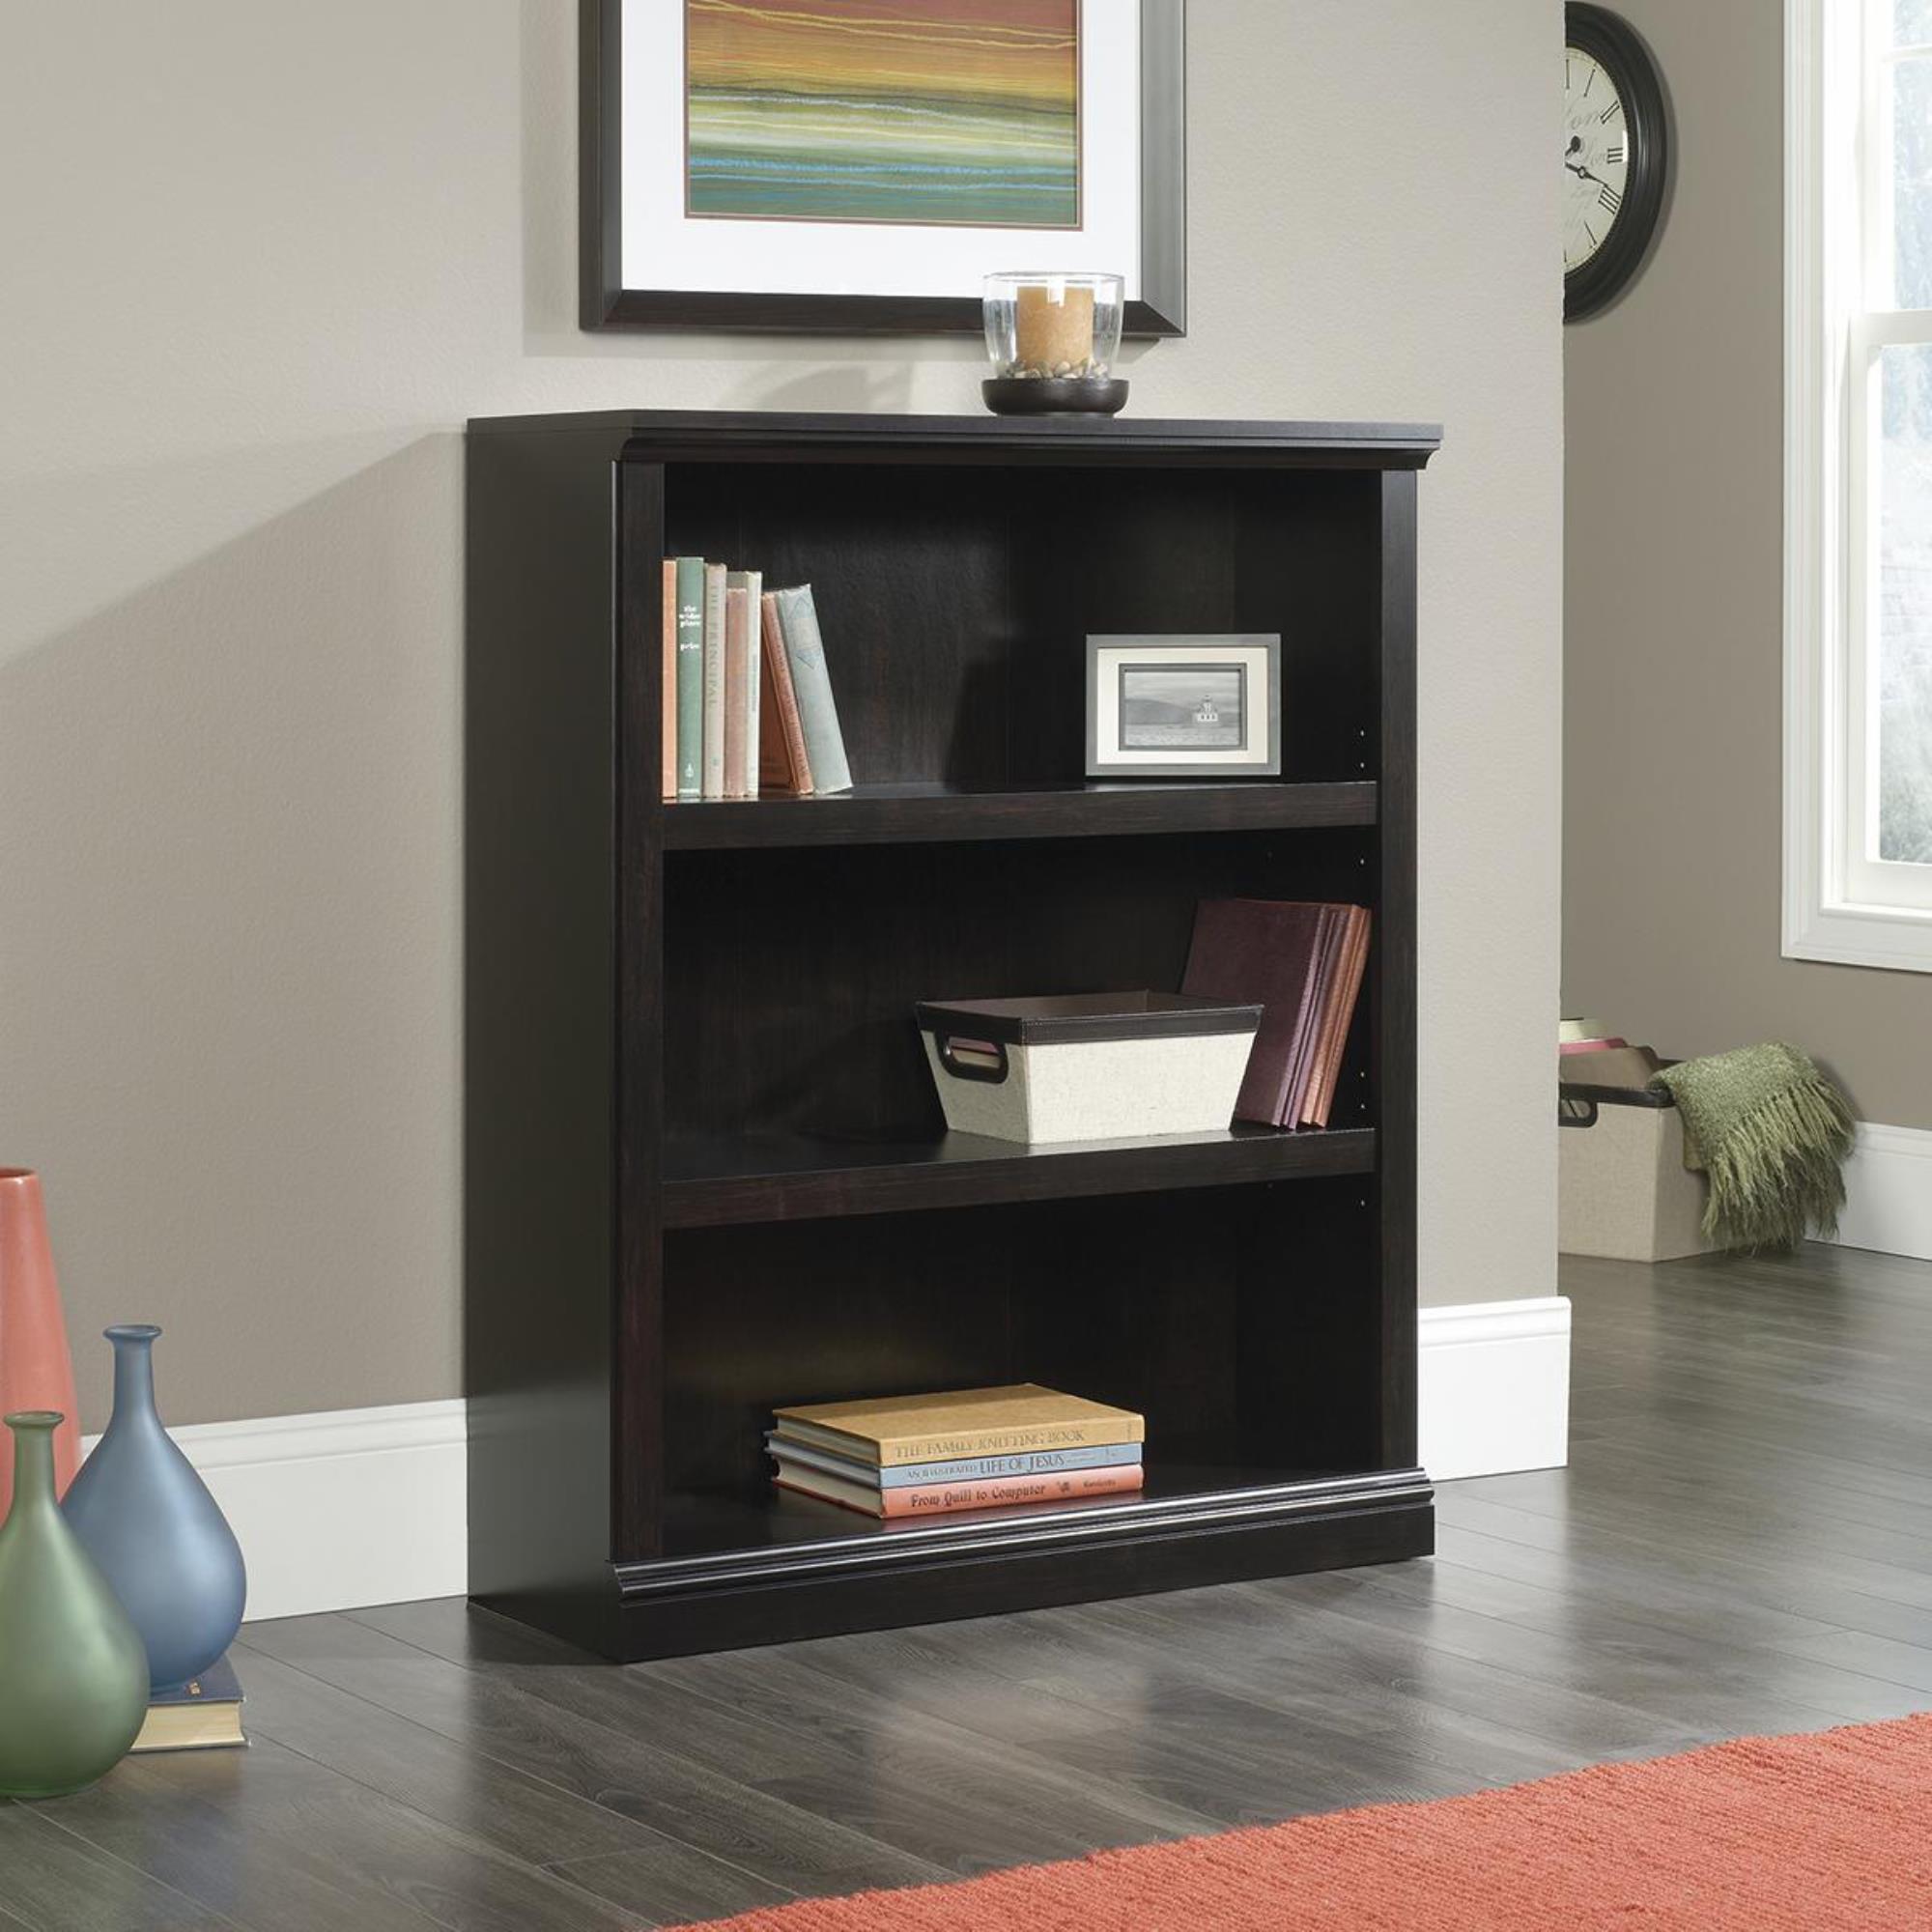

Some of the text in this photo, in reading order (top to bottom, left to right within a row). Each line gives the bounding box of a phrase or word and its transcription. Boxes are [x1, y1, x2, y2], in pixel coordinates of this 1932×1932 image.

[1606, 147, 1624, 164] III
[895, 1430, 1085, 1458] THE FAMILY KNITTING BOOK
[980, 1459, 1006, 1474] LIFE
[1009, 1456, 1025, 1470] OF
[1026, 1453, 1065, 1473] JESUS
[911, 1485, 1046, 1507] From Quill to Computer
